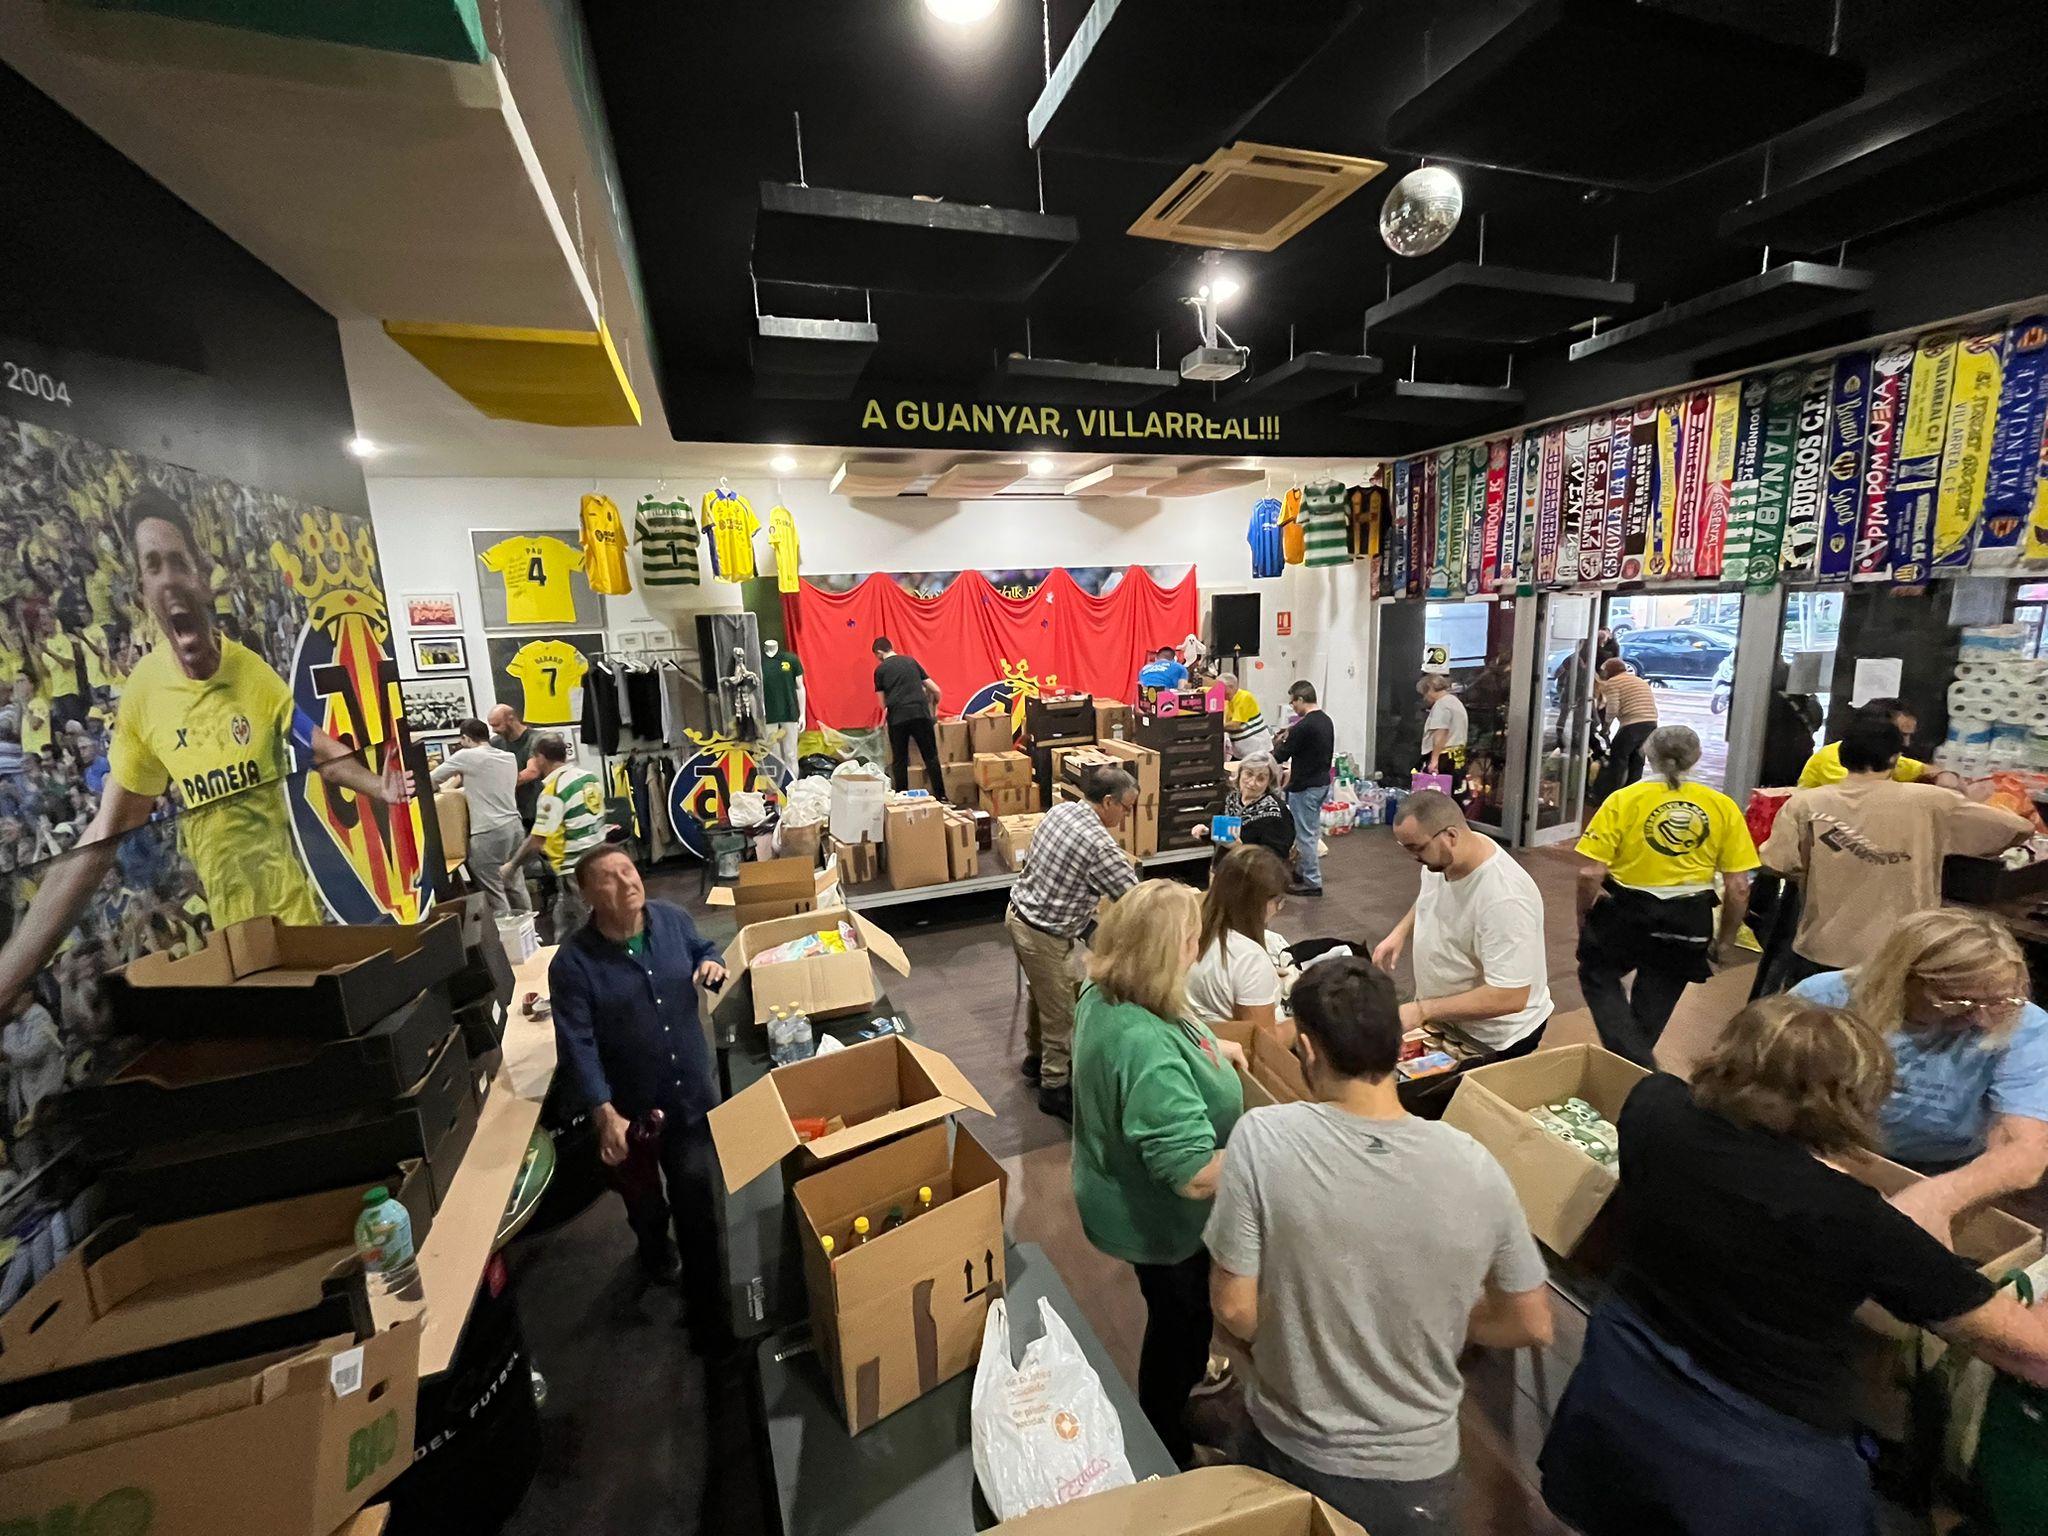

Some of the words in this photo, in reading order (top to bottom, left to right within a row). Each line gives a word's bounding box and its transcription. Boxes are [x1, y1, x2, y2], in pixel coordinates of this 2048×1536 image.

[3, 361, 73, 407] 2004
[862, 399, 887, 429] A
[895, 400, 1069, 438] GUANYAR,
[1076, 409, 1280, 440] VILLARREAL!!!
[1745, 407, 1760, 466] SOUNDERS
[1596, 442, 1609, 483] F.C.
[1790, 435, 1822, 519] BURGOS
[1865, 450, 1889, 495] POM
[1473, 472, 1487, 511] CELTIC
[1488, 477, 1501, 492] FC
[1585, 462, 1597, 506] DRAGONS
[1609, 476, 1627, 500] LA
[1631, 444, 1647, 536] VETERANEN
[1485, 499, 1501, 559] LIVERPOOL
[1589, 489, 1605, 548] METZ
[525, 547, 543, 555] PAU
[528, 557, 547, 586] 4
[666, 541, 679, 567] 1
[1503, 542, 1514, 565] PENYA
[542, 668, 557, 696] 7
[183, 760, 261, 804] PAMESA
[414, 1426, 457, 1462] DEL
